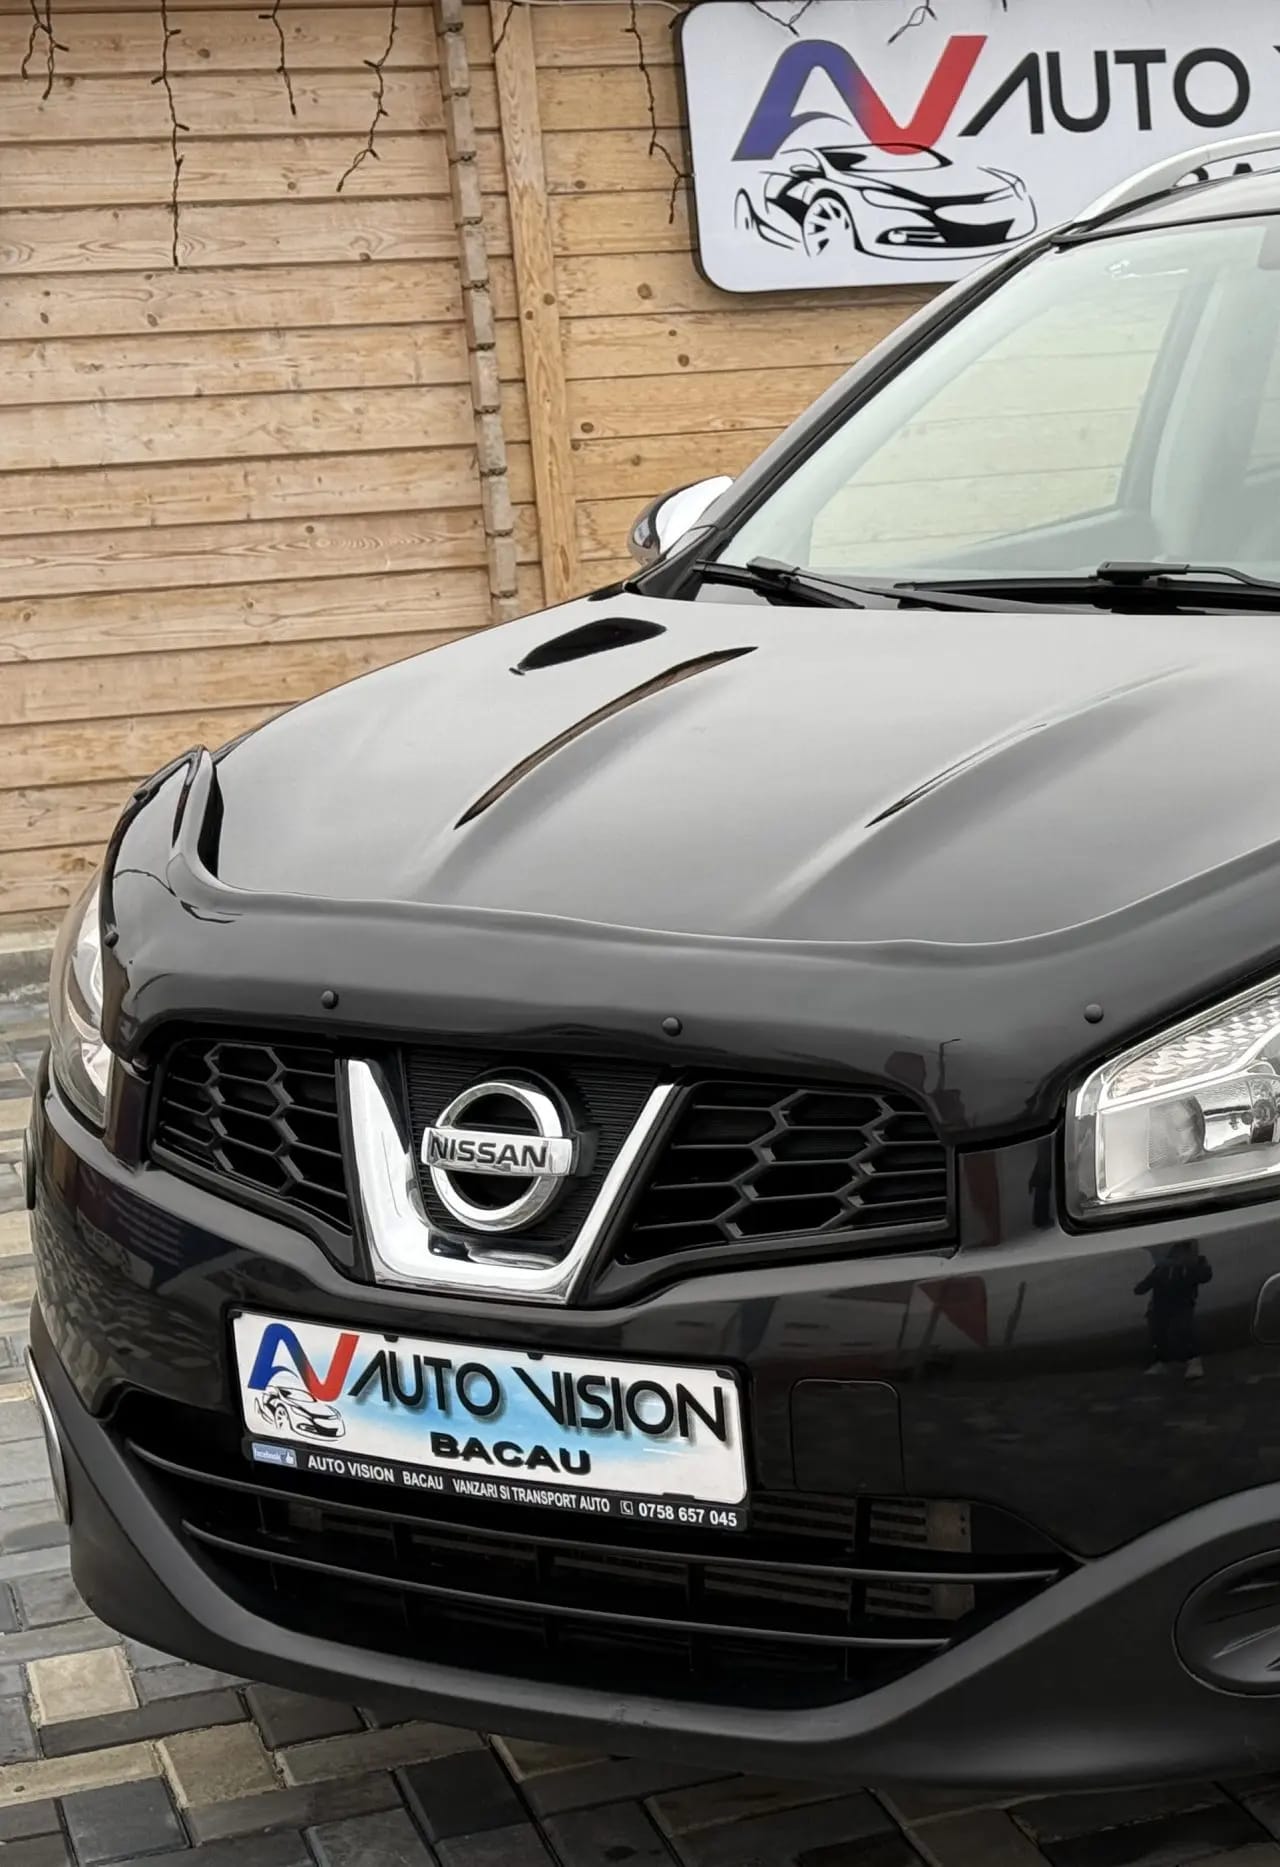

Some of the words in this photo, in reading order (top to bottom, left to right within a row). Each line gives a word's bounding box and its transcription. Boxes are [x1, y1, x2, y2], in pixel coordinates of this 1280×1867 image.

[958, 48, 1250, 137] AUTO
[429, 1136, 547, 1168] NISSAN
[348, 1348, 500, 1417] AUTO
[511, 1366, 728, 1442] VISION
[430, 1431, 591, 1475] BACAU
[307, 1455, 345, 1474] AUTO
[348, 1461, 395, 1483] VISION
[402, 1471, 444, 1490] BACAU
[452, 1478, 498, 1498] VANZARI
[499, 1485, 510, 1500] SI
[511, 1487, 577, 1509] TRANSPORT
[579, 1496, 611, 1513] AUTO
[638, 1502, 675, 1521] 0758
[678, 1507, 705, 1523] 657
[709, 1510, 738, 1527] 045
